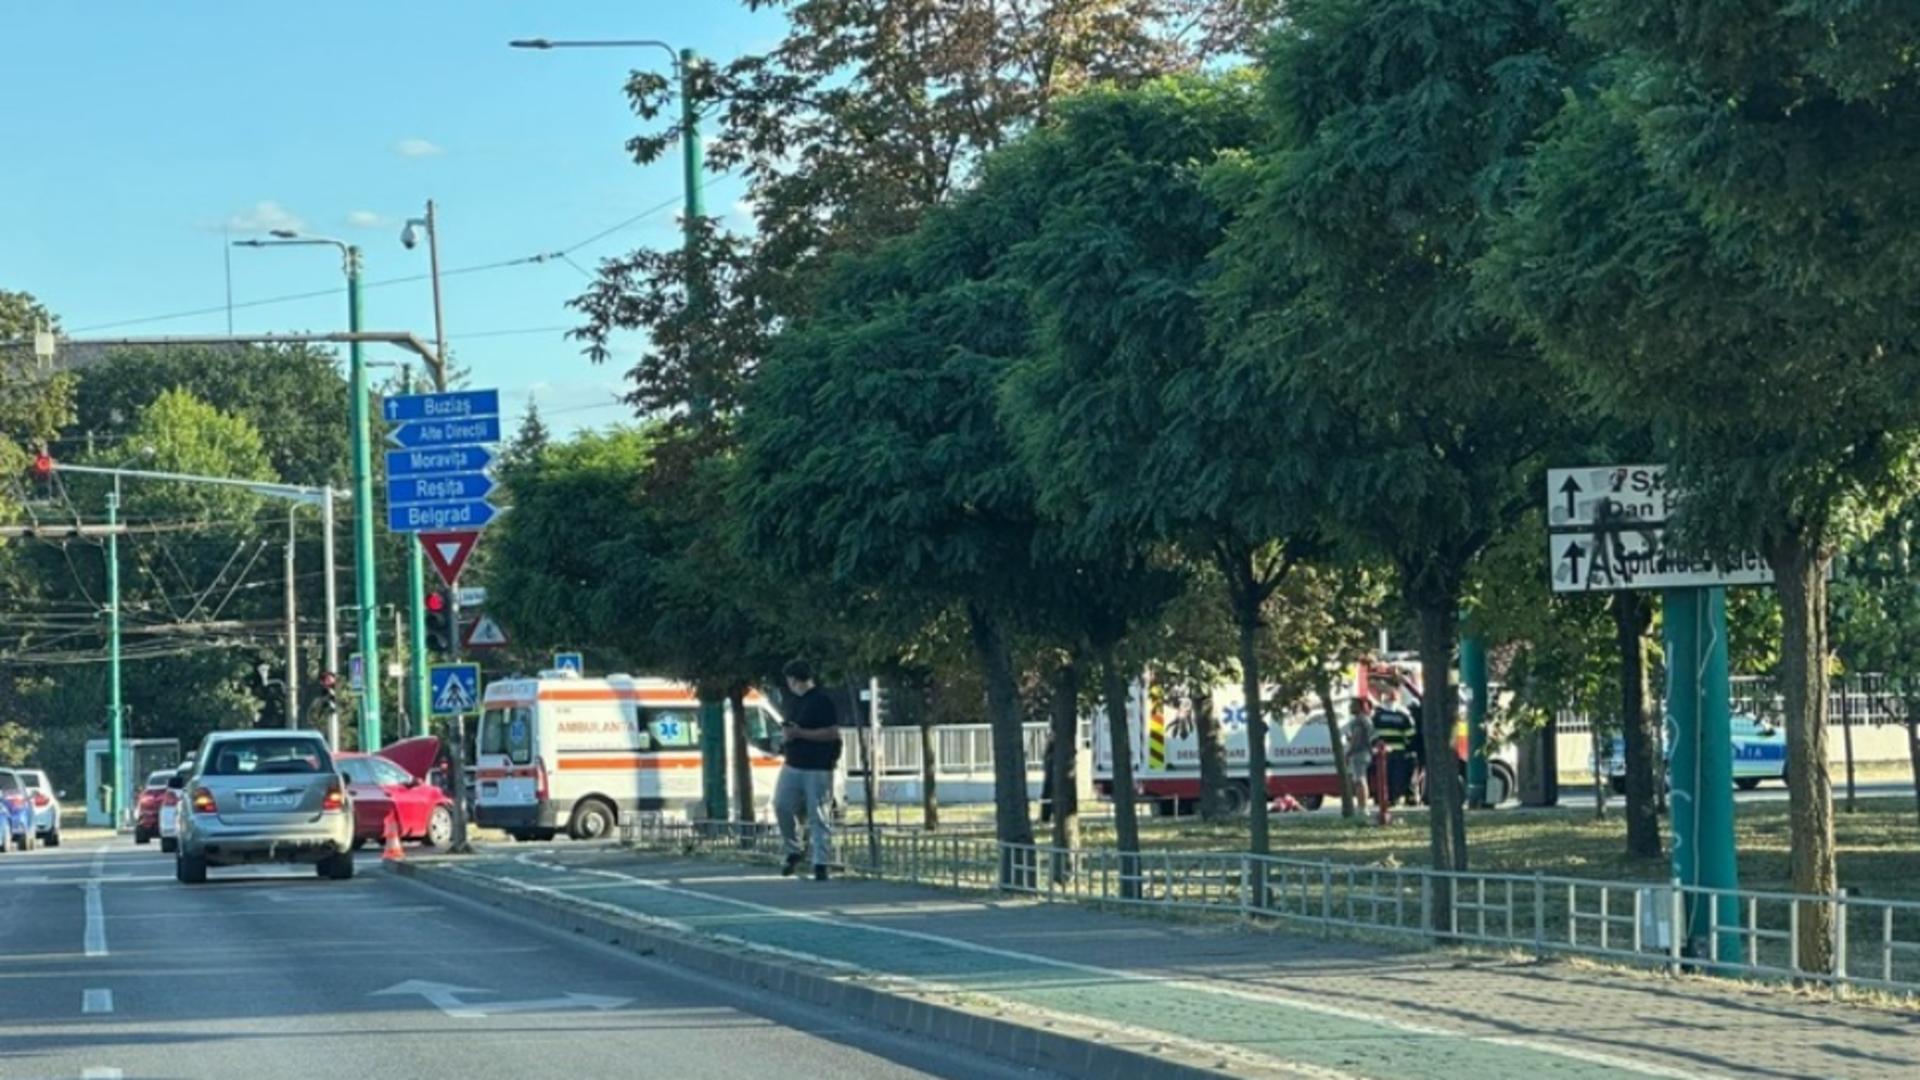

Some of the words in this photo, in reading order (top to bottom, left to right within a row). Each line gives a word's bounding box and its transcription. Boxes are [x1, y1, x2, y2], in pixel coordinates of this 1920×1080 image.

[424, 396, 471, 417] Buziaș
[420, 425, 442, 440] Alte
[411, 451, 467, 470] Moravița
[409, 503, 470, 528] Belgrad
[1606, 500, 1654, 517] Dan
